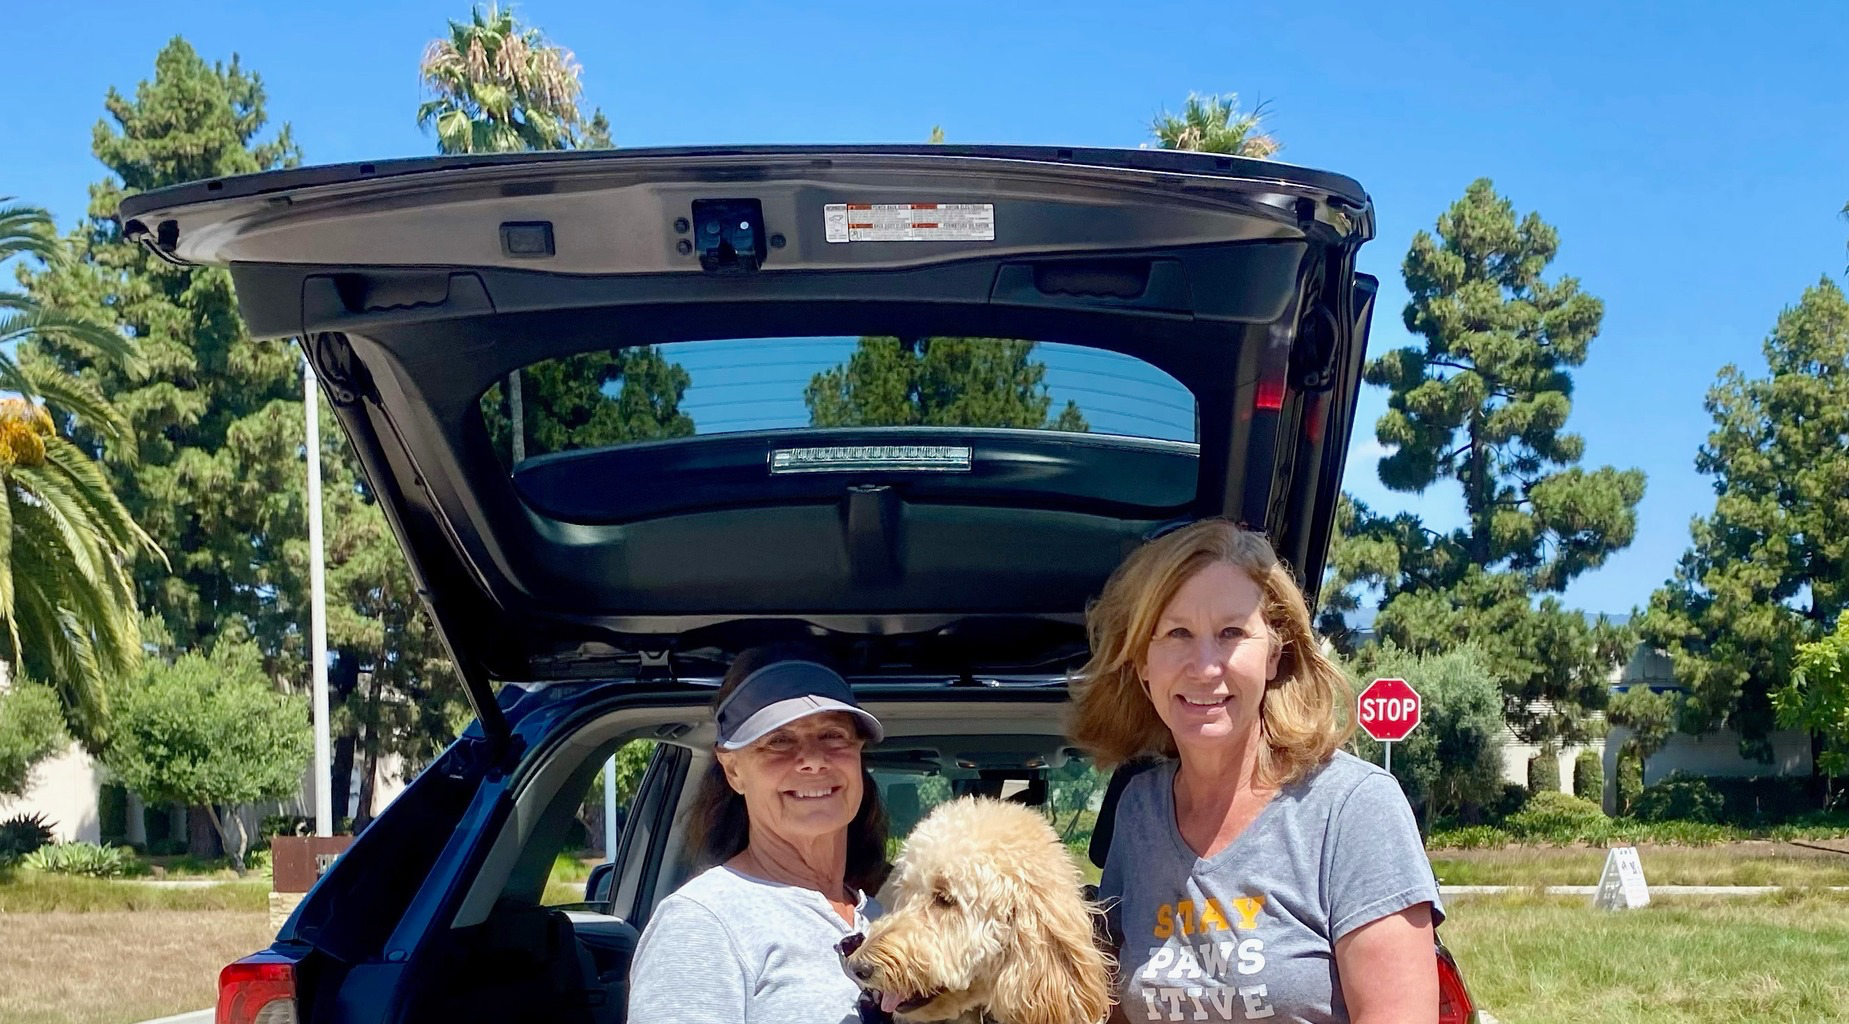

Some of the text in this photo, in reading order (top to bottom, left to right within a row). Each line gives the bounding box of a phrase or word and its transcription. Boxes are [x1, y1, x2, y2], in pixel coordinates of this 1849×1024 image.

[1362, 697, 1416, 722] STOP
[1153, 895, 1267, 939] STAY
[1141, 938, 1266, 980] PAWS
[1141, 983, 1275, 1022] ITIVE
